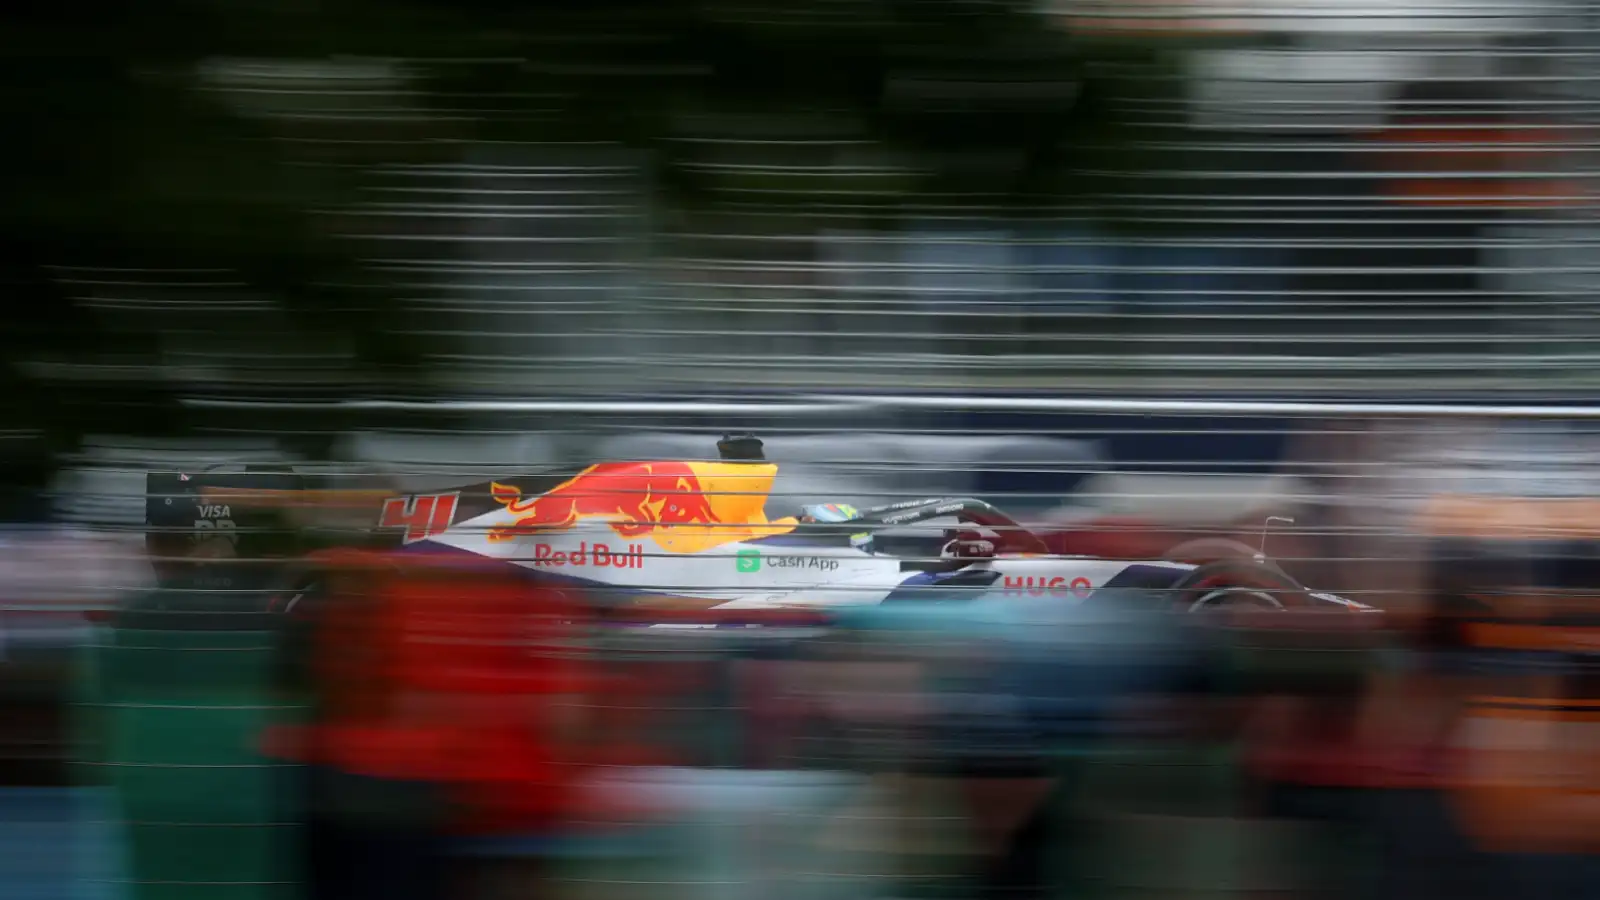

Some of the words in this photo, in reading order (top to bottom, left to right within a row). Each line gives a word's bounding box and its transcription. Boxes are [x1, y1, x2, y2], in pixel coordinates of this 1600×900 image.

[196, 505, 230, 518] VISA
[379, 491, 460, 544] 41
[535, 541, 587, 567] Red
[593, 543, 643, 568] Bull
[766, 555, 805, 568] Cash
[808, 555, 840, 571] App
[1003, 576, 1092, 597] HUGO
